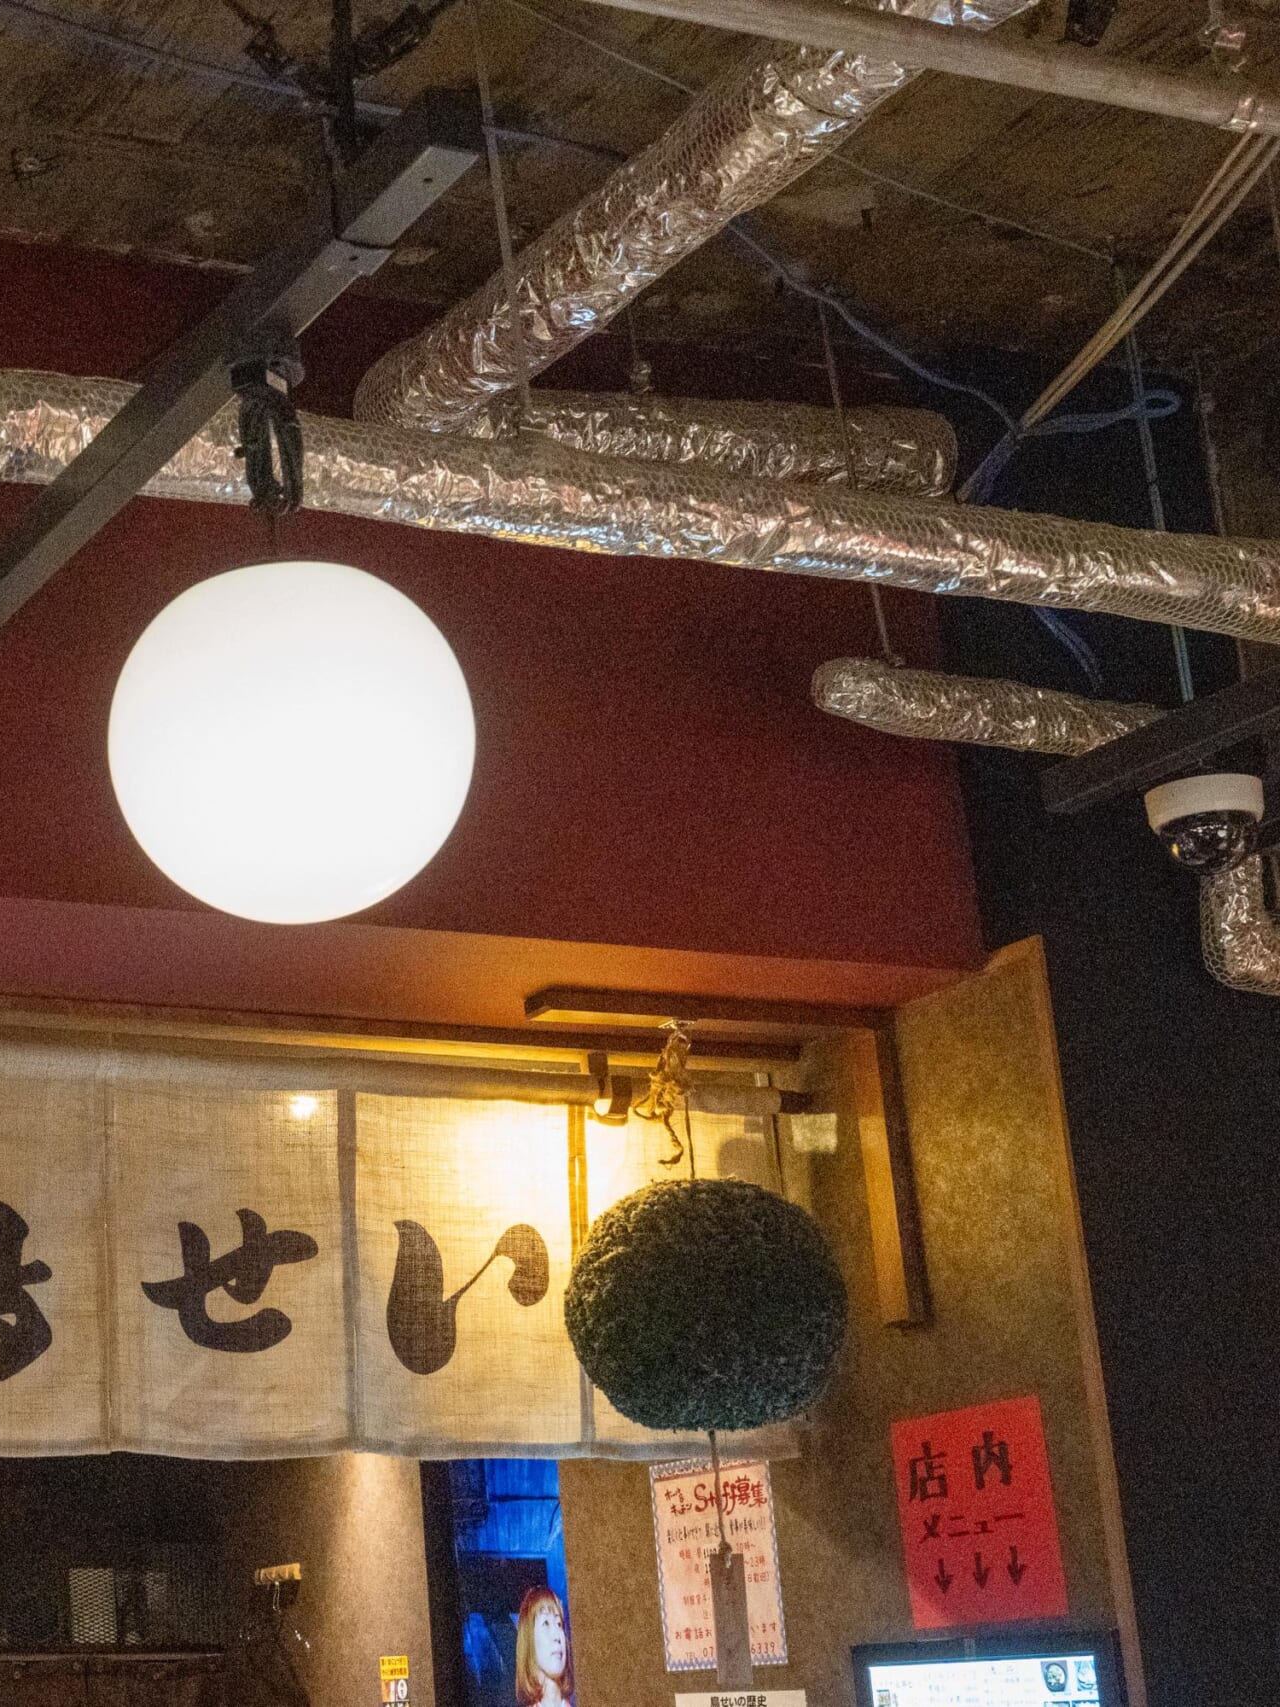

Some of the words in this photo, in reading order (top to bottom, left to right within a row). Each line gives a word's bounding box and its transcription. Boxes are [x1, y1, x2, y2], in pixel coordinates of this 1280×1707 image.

[908, 1431, 1012, 1502] 店内
[921, 1512, 1025, 1544] メニュー
